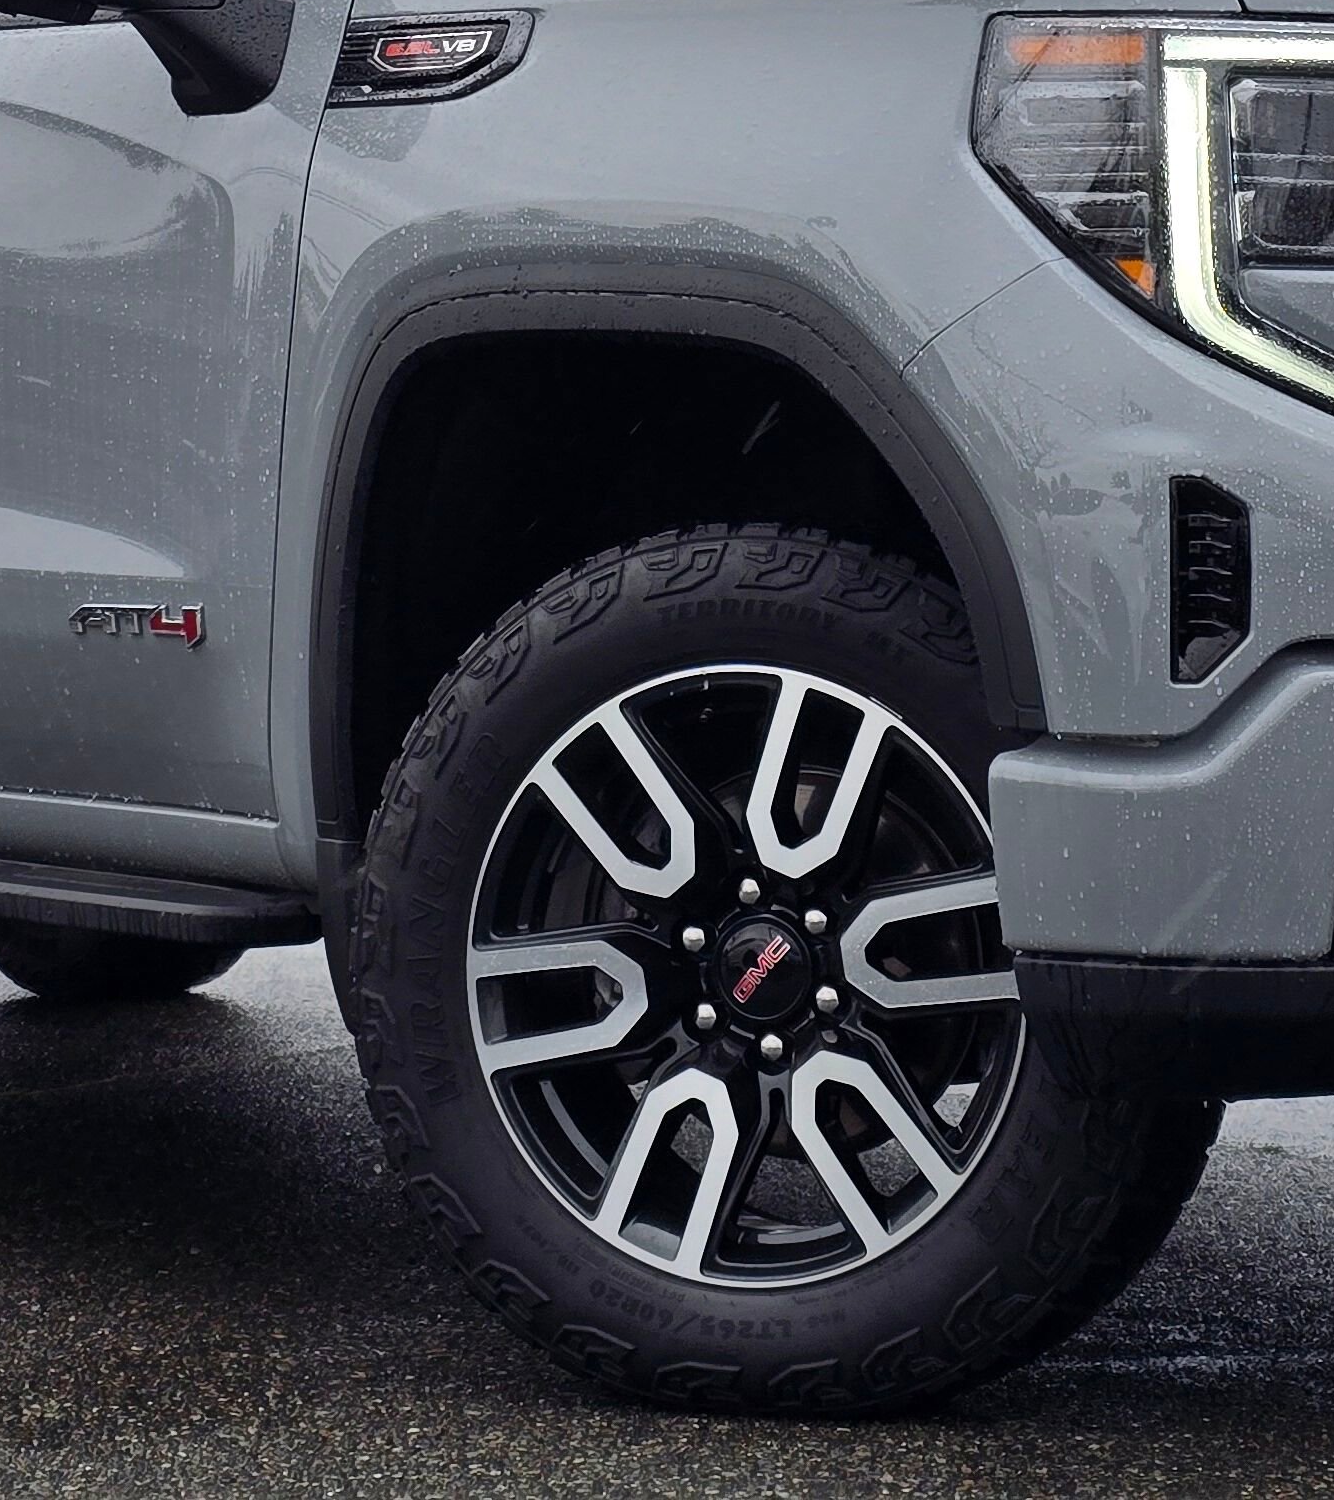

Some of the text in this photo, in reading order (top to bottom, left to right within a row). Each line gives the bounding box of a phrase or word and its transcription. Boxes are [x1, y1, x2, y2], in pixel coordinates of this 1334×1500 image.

[442, 38, 477, 53] V8
[67, 602, 204, 651] AT4
[732, 934, 792, 1004] GMC
